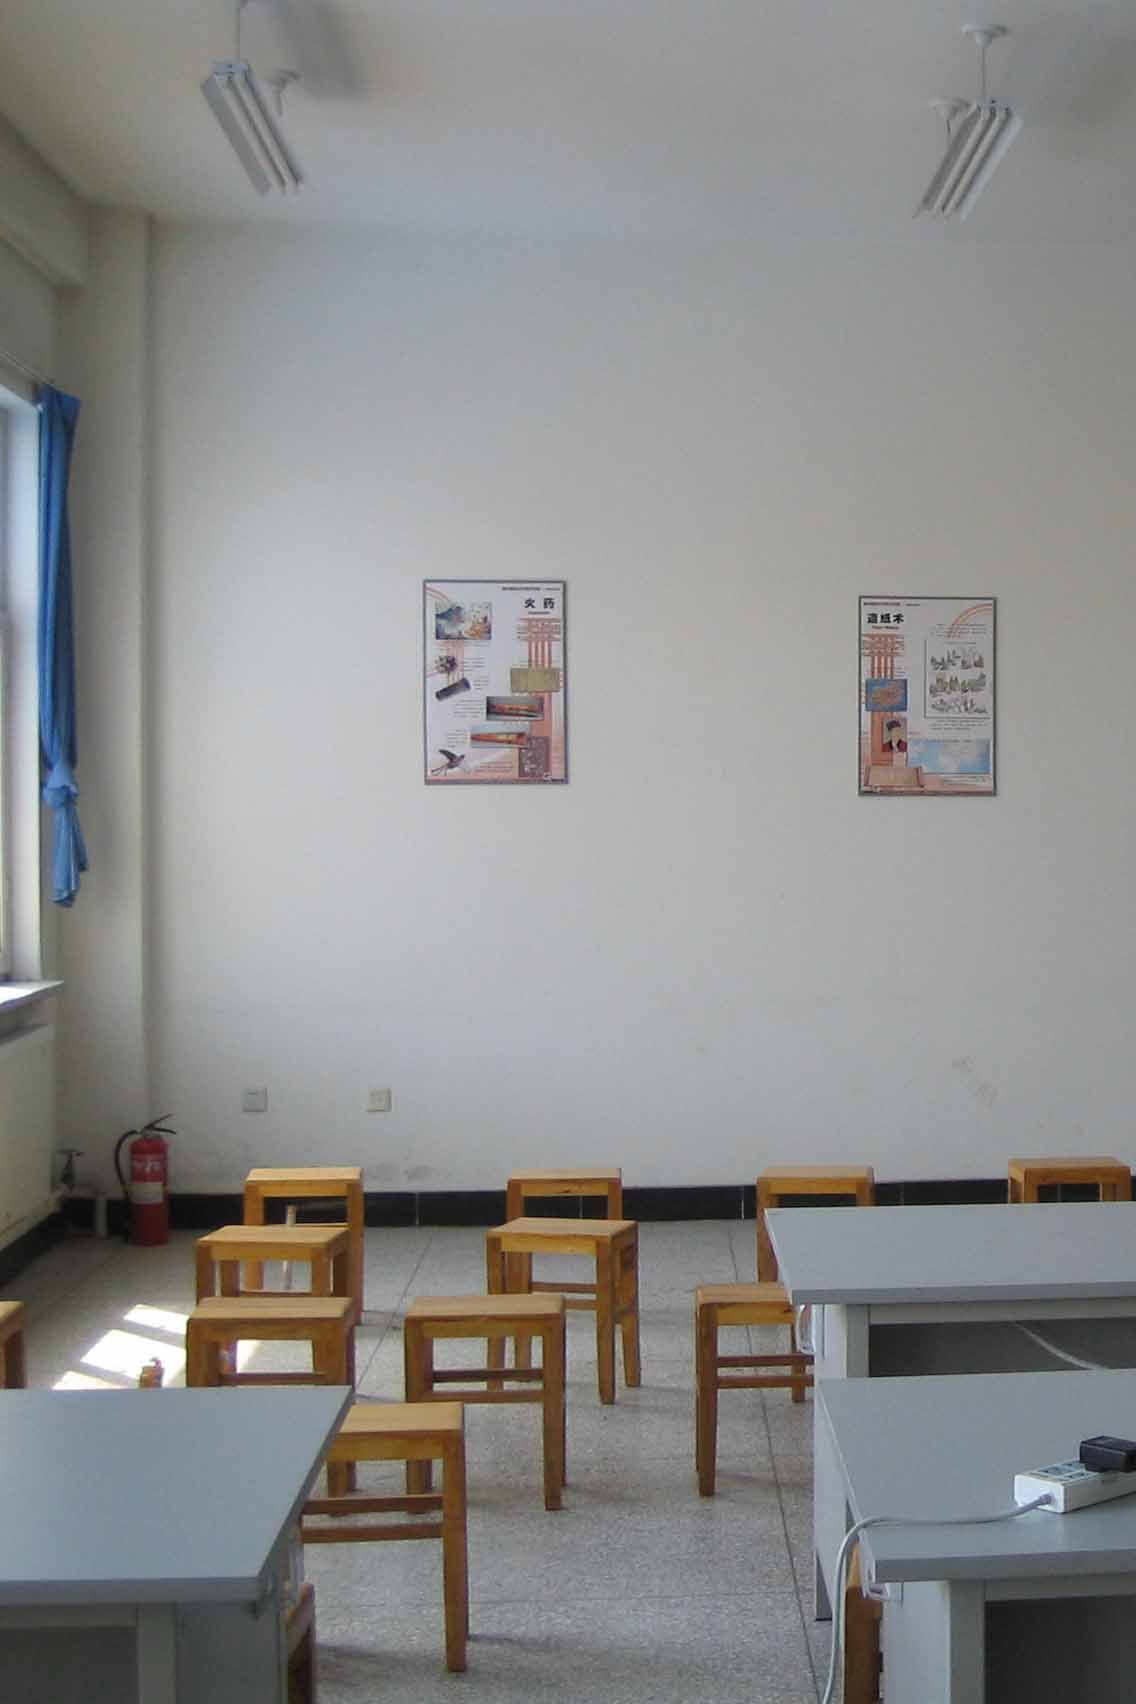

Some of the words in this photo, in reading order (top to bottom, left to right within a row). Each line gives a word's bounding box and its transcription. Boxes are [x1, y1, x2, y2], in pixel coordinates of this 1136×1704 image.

[524, 596, 556, 609] 火药
[867, 612, 905, 624] 造纸术
